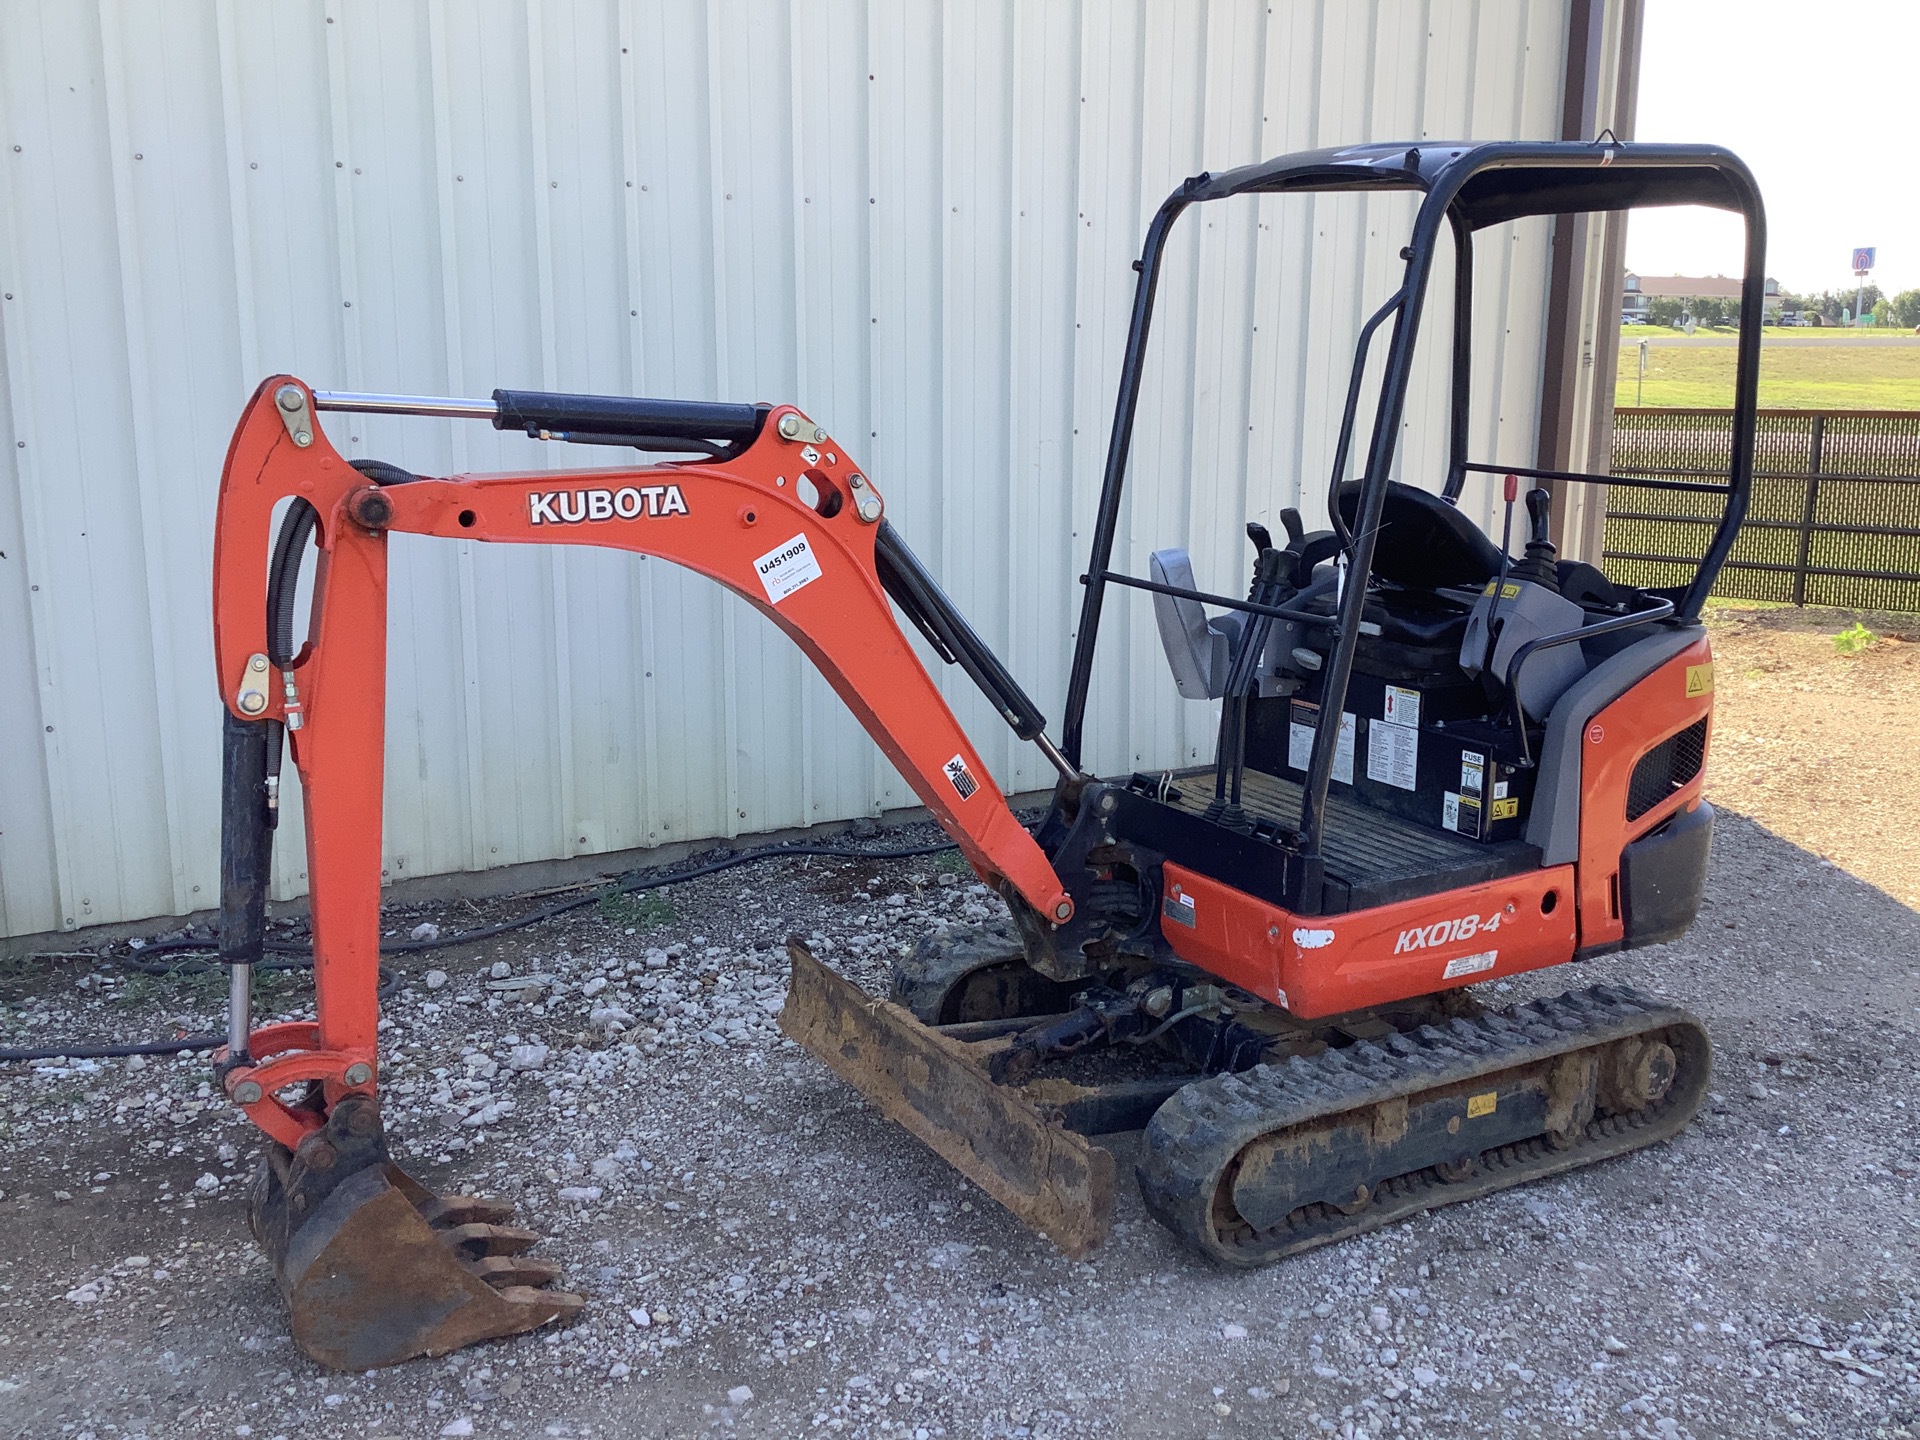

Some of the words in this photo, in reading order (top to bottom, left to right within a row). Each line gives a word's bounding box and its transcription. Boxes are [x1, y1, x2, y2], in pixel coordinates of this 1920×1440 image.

[1856, 248, 1869, 270] 6
[530, 485, 688, 524] KUBOTA
[760, 542, 806, 574] U451909
[1464, 752, 1482, 763] FUSE
[1393, 912, 1502, 955] KX018-4
